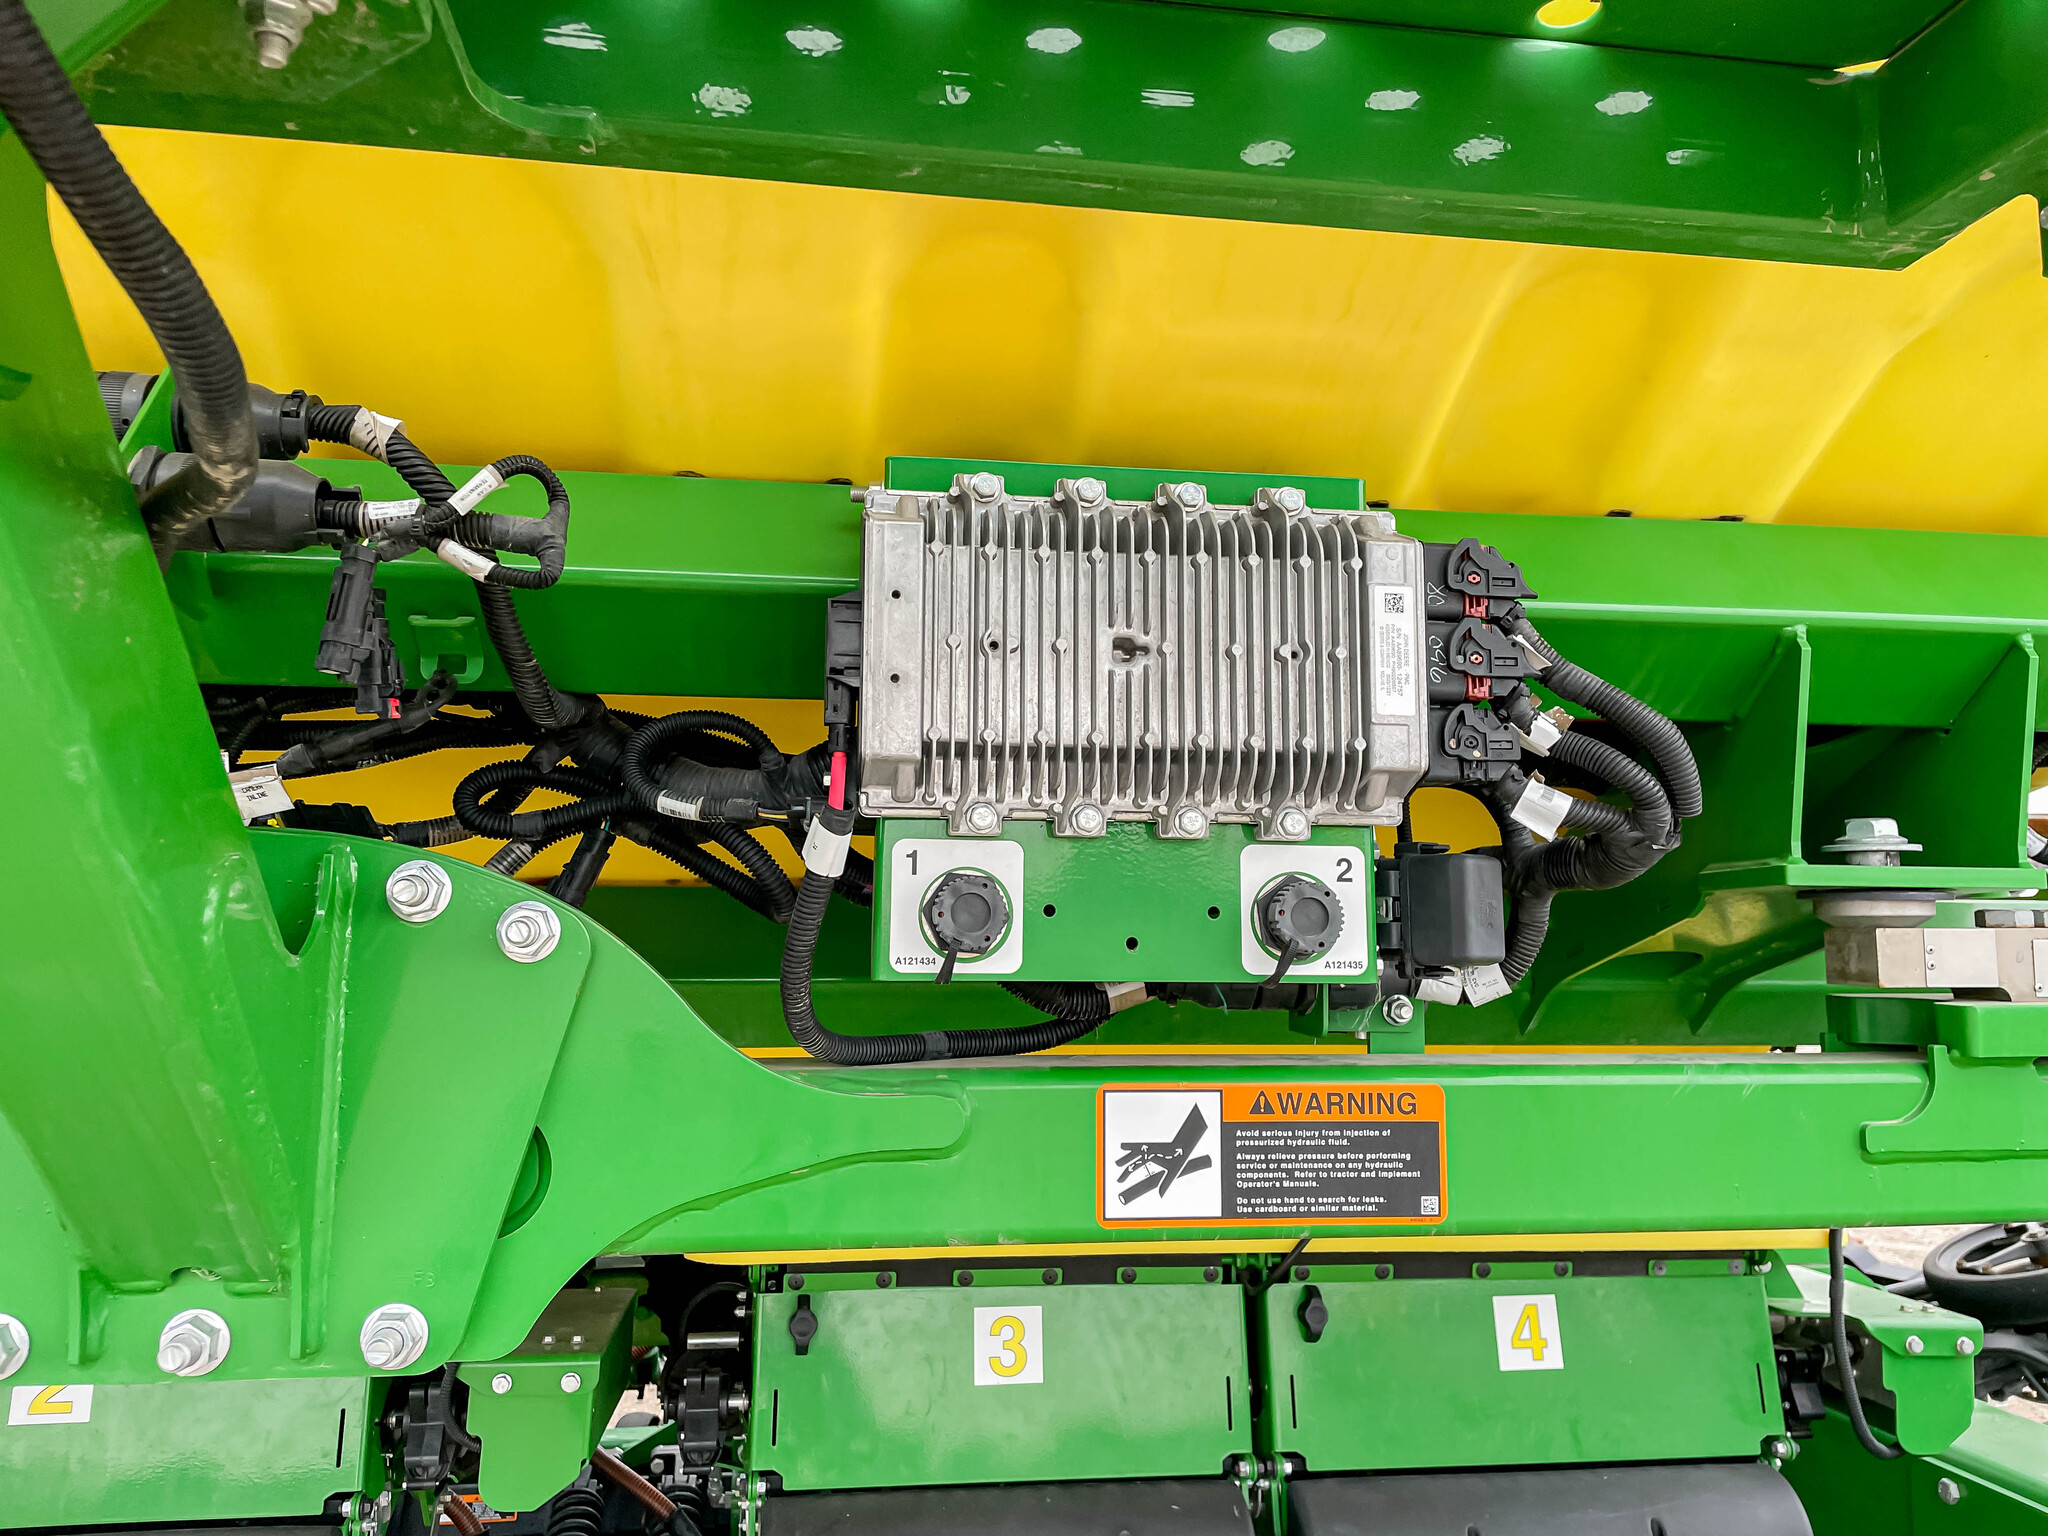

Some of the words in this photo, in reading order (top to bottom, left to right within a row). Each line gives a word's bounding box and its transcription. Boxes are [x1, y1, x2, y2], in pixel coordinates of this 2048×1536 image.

[906, 850, 917, 875] 1
[1337, 858, 1352, 882] 2
[895, 957, 936, 968] A121434
[1276, 1092, 1417, 1115] WARNING
[1295, 1130, 1319, 1138] injury
[1322, 1129, 1341, 1137] from
[1344, 1130, 1380, 1138] injection
[1382, 1129, 1391, 1137] of
[1236, 1139, 1285, 1148] pressurized
[1287, 1139, 1326, 1148] hydraulic
[1236, 1153, 1265, 1162] Always
[1338, 1152, 1364, 1160] before
[1366, 1152, 1411, 1161] performing
[1236, 1162, 1267, 1170] service
[1365, 1161, 1403, 1170] hydraulic
[1236, 1172, 1289, 1180] components.
[1294, 1171, 1317, 1179] Refer
[1378, 1171, 1420, 1179] implement
[1237, 1181, 1280, 1190] Operator's
[1283, 1180, 1319, 1188] Manuals.
[1237, 1197, 1248, 1205] Do
[1251, 1197, 1264, 1205] not
[1318, 1196, 1345, 1204] search
[1348, 1196, 1360, 1204] for
[1363, 1196, 1387, 1204] leaks.
[1237, 1206, 1252, 1214] Use
[1255, 1205, 1297, 1213] cardboard
[1342, 1204, 1378, 1212] material.
[1512, 1305, 1547, 1360] 4
[990, 1316, 1026, 1376] 3
